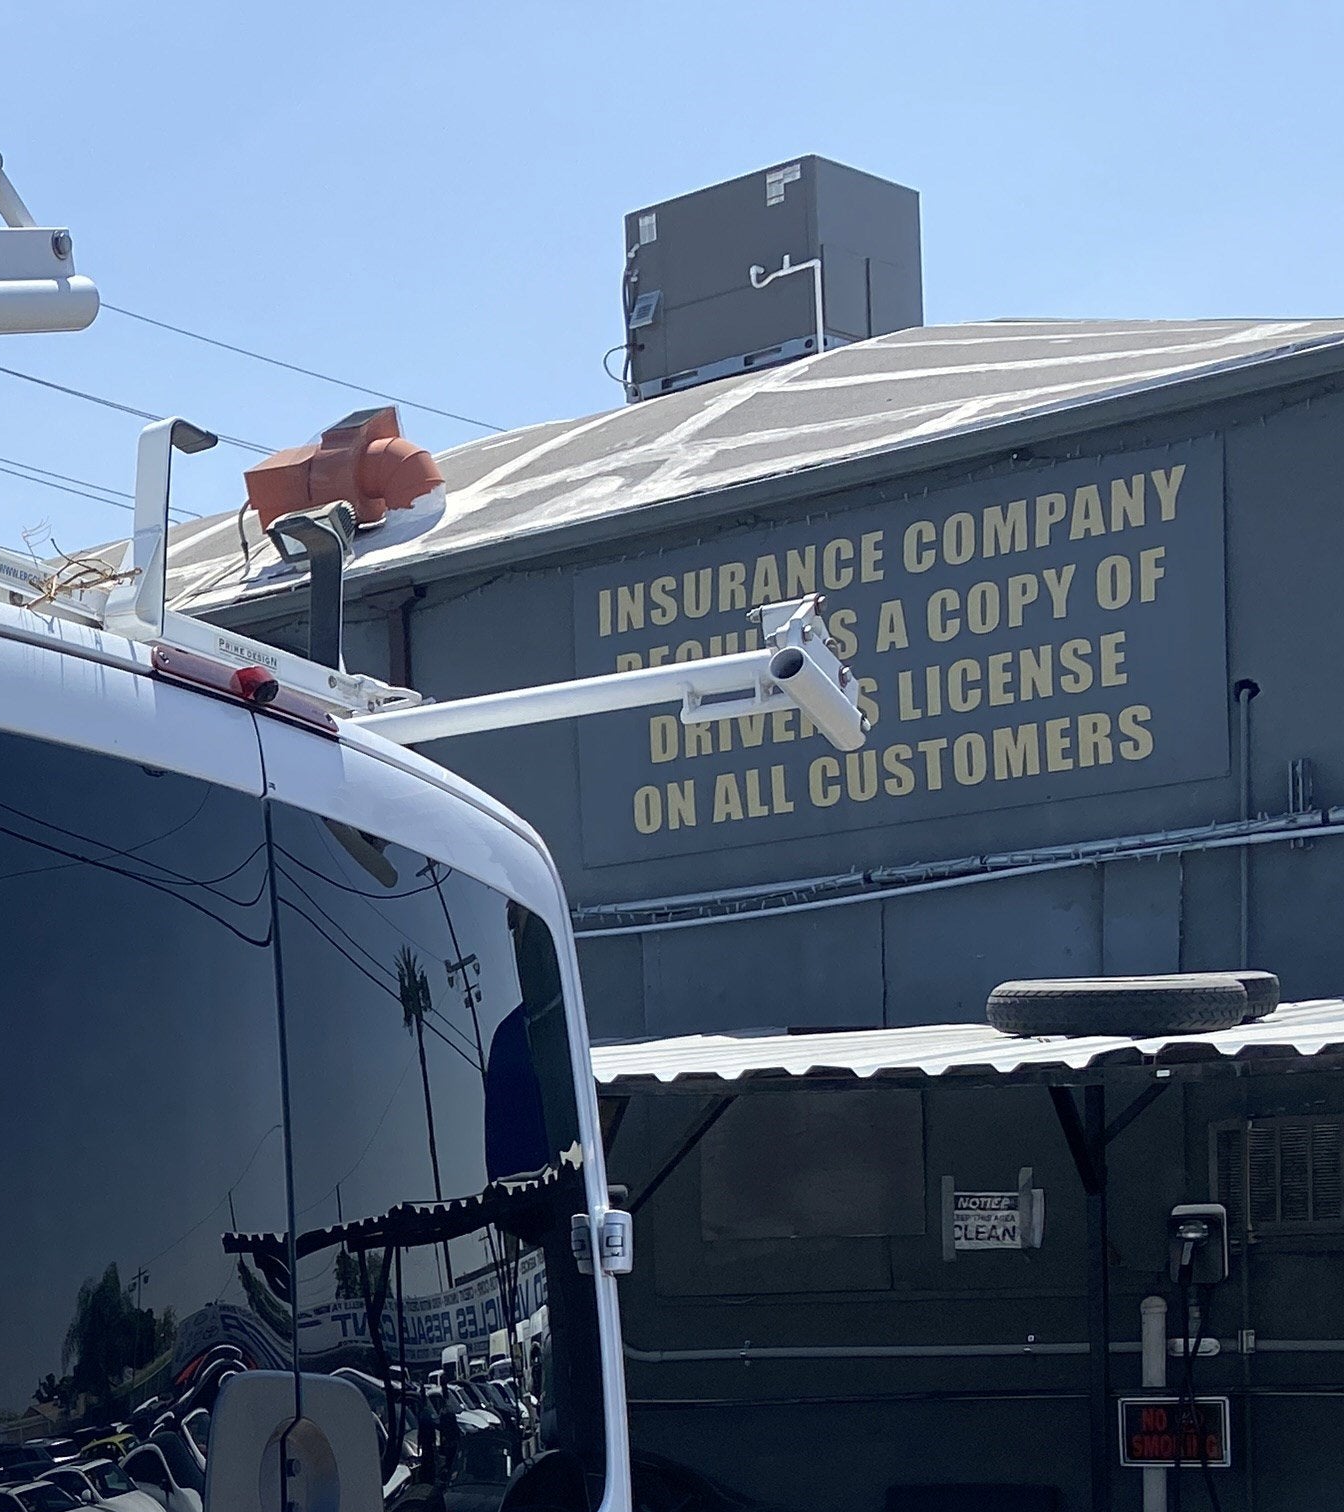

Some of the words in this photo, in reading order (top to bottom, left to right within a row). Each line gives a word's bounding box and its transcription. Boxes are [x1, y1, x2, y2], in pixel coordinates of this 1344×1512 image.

[598, 531, 884, 637] INSURANCE
[903, 465, 1186, 574] COMPANY
[876, 600, 909, 652] A
[927, 564, 1076, 642] COPY
[1096, 547, 1165, 610] OF
[219, 638, 245, 656] PRIME
[247, 652, 277, 667] DESIGN
[898, 631, 1127, 721] LICENSE
[634, 780, 696, 834] ON
[713, 764, 795, 823] ALL
[810, 704, 1154, 807] CUSTOMERS
[1132, 1433, 1220, 1458] SMOIG
[1142, 1408, 1167, 1431] NO
